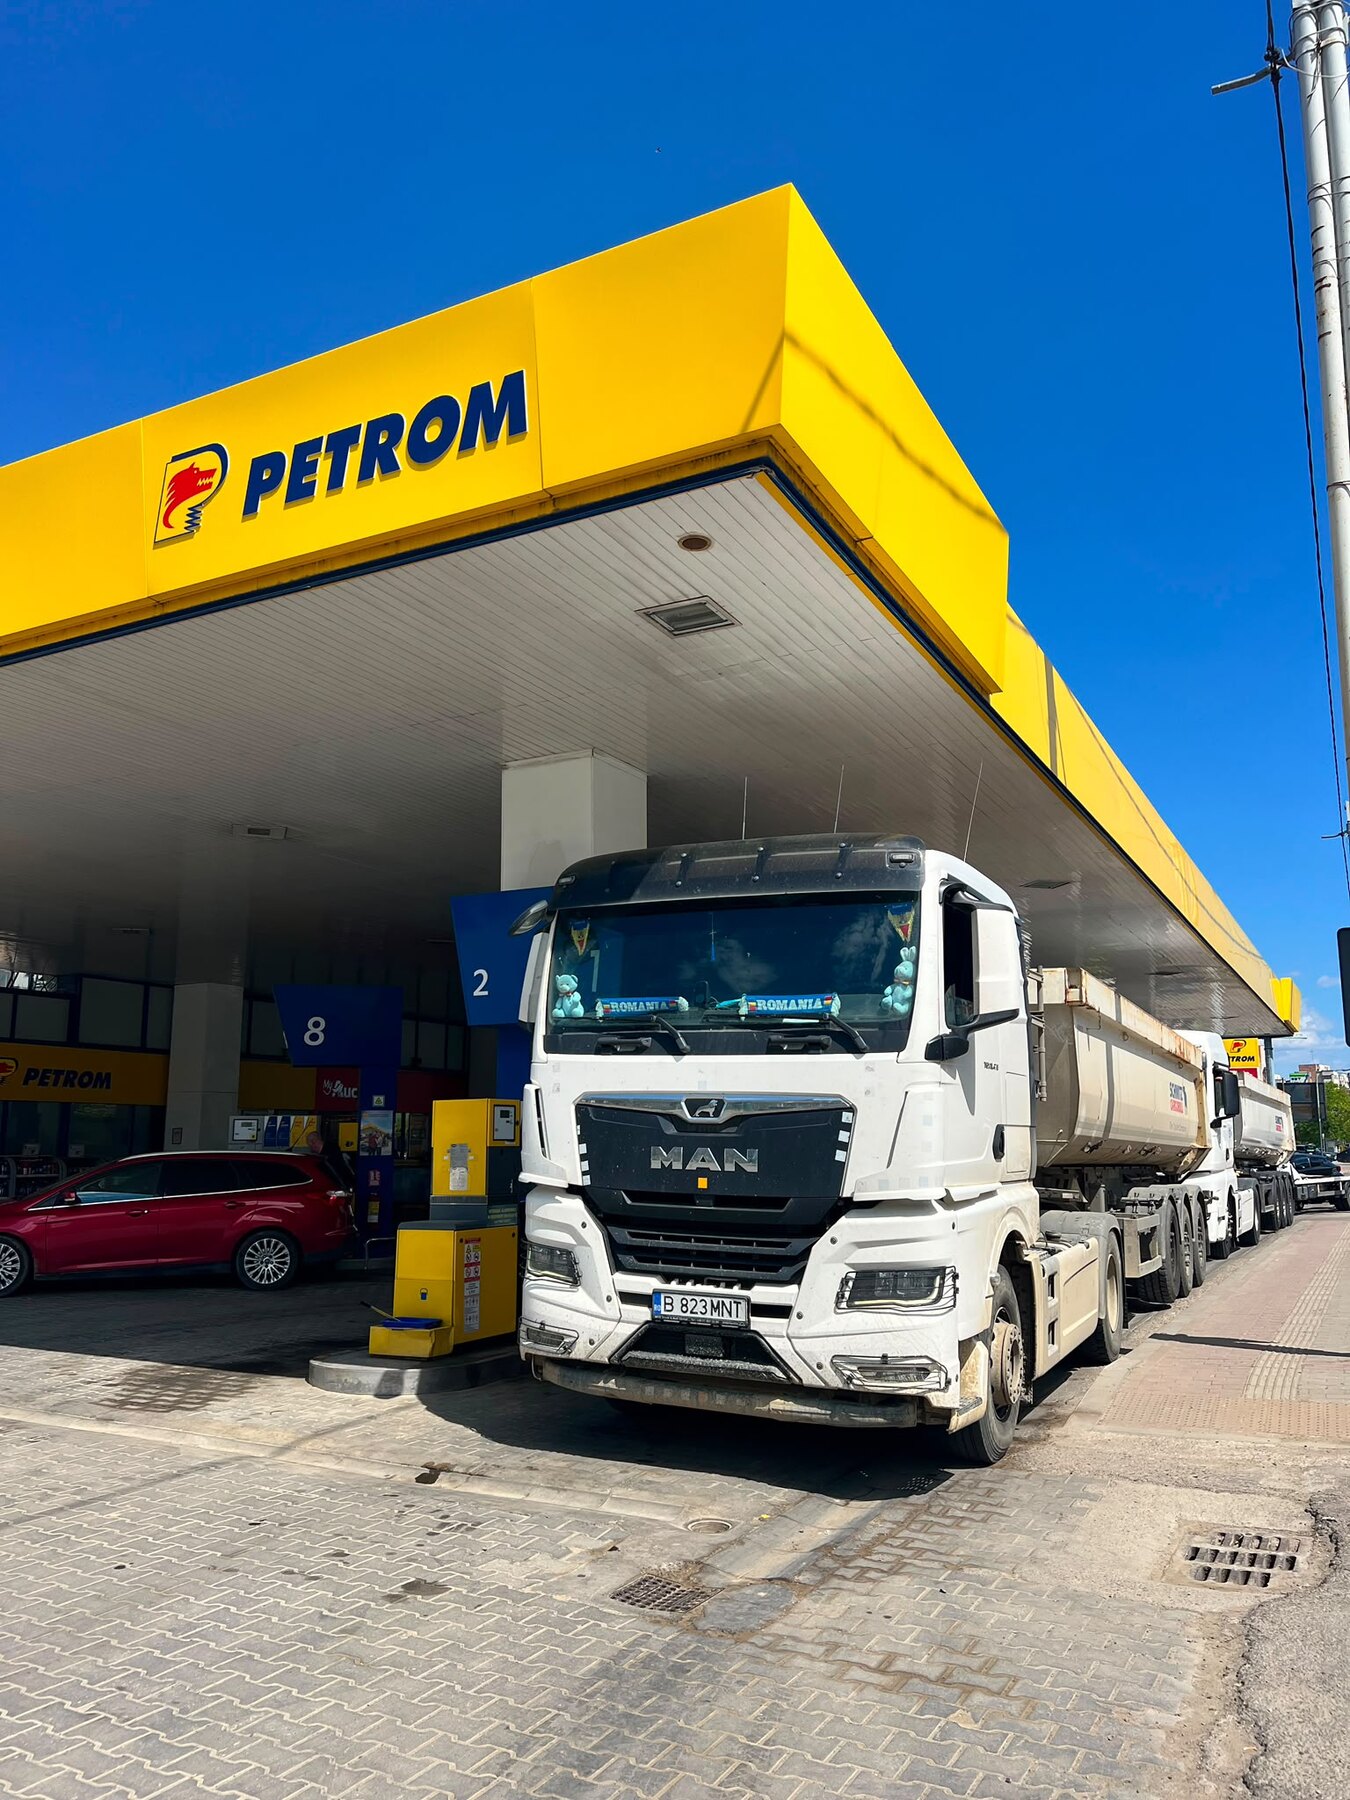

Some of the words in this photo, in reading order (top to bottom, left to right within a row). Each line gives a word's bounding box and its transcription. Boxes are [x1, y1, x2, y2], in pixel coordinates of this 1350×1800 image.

[242, 369, 528, 518] PETROM
[473, 969, 489, 996] 2
[610, 1001, 670, 1013] ROMANIA
[756, 998, 822, 1011] ROMANIA
[304, 1016, 326, 1046] 8
[22, 1067, 112, 1090] PETROM
[650, 1146, 758, 1173] MAN
[664, 1296, 674, 1312] B
